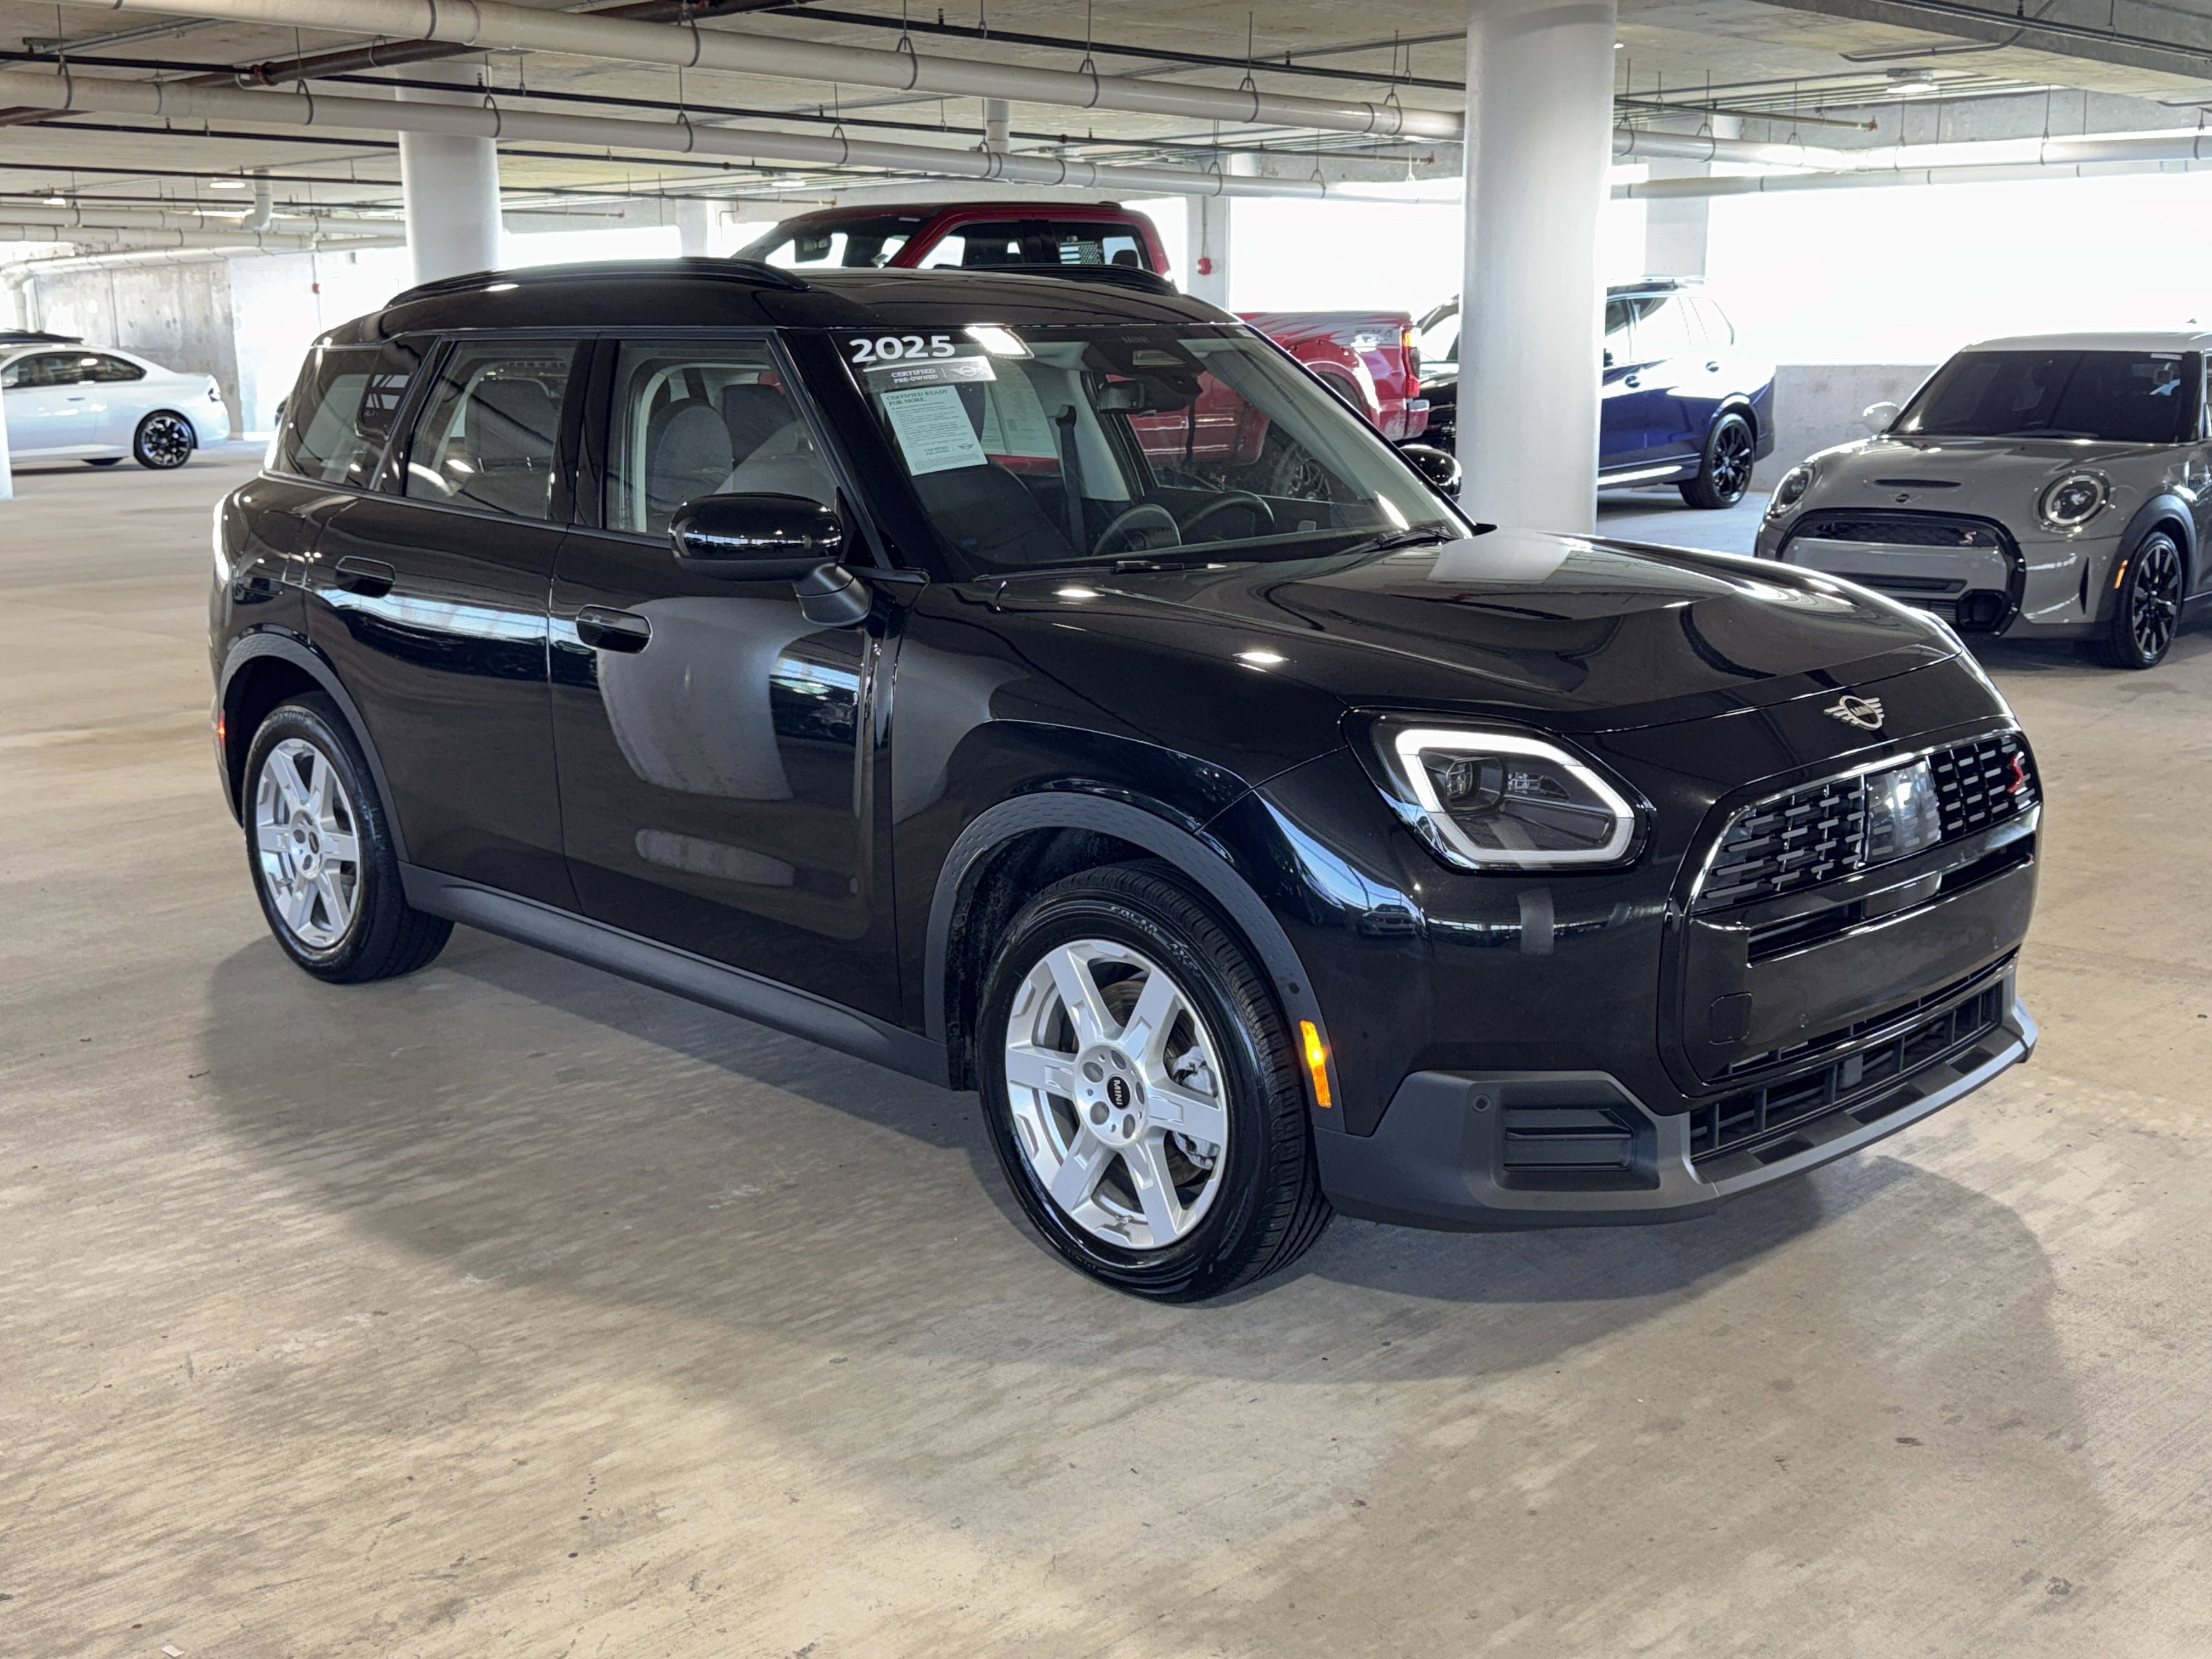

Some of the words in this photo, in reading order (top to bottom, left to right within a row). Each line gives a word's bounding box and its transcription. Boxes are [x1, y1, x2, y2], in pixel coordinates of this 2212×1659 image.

[849, 335, 956, 363] 2025
[891, 368, 936, 378] CERTIFIED
[894, 374, 938, 384] PRE-OWNED
[1849, 705, 1875, 716] MINI
[1113, 1079, 1124, 1105] MINI
